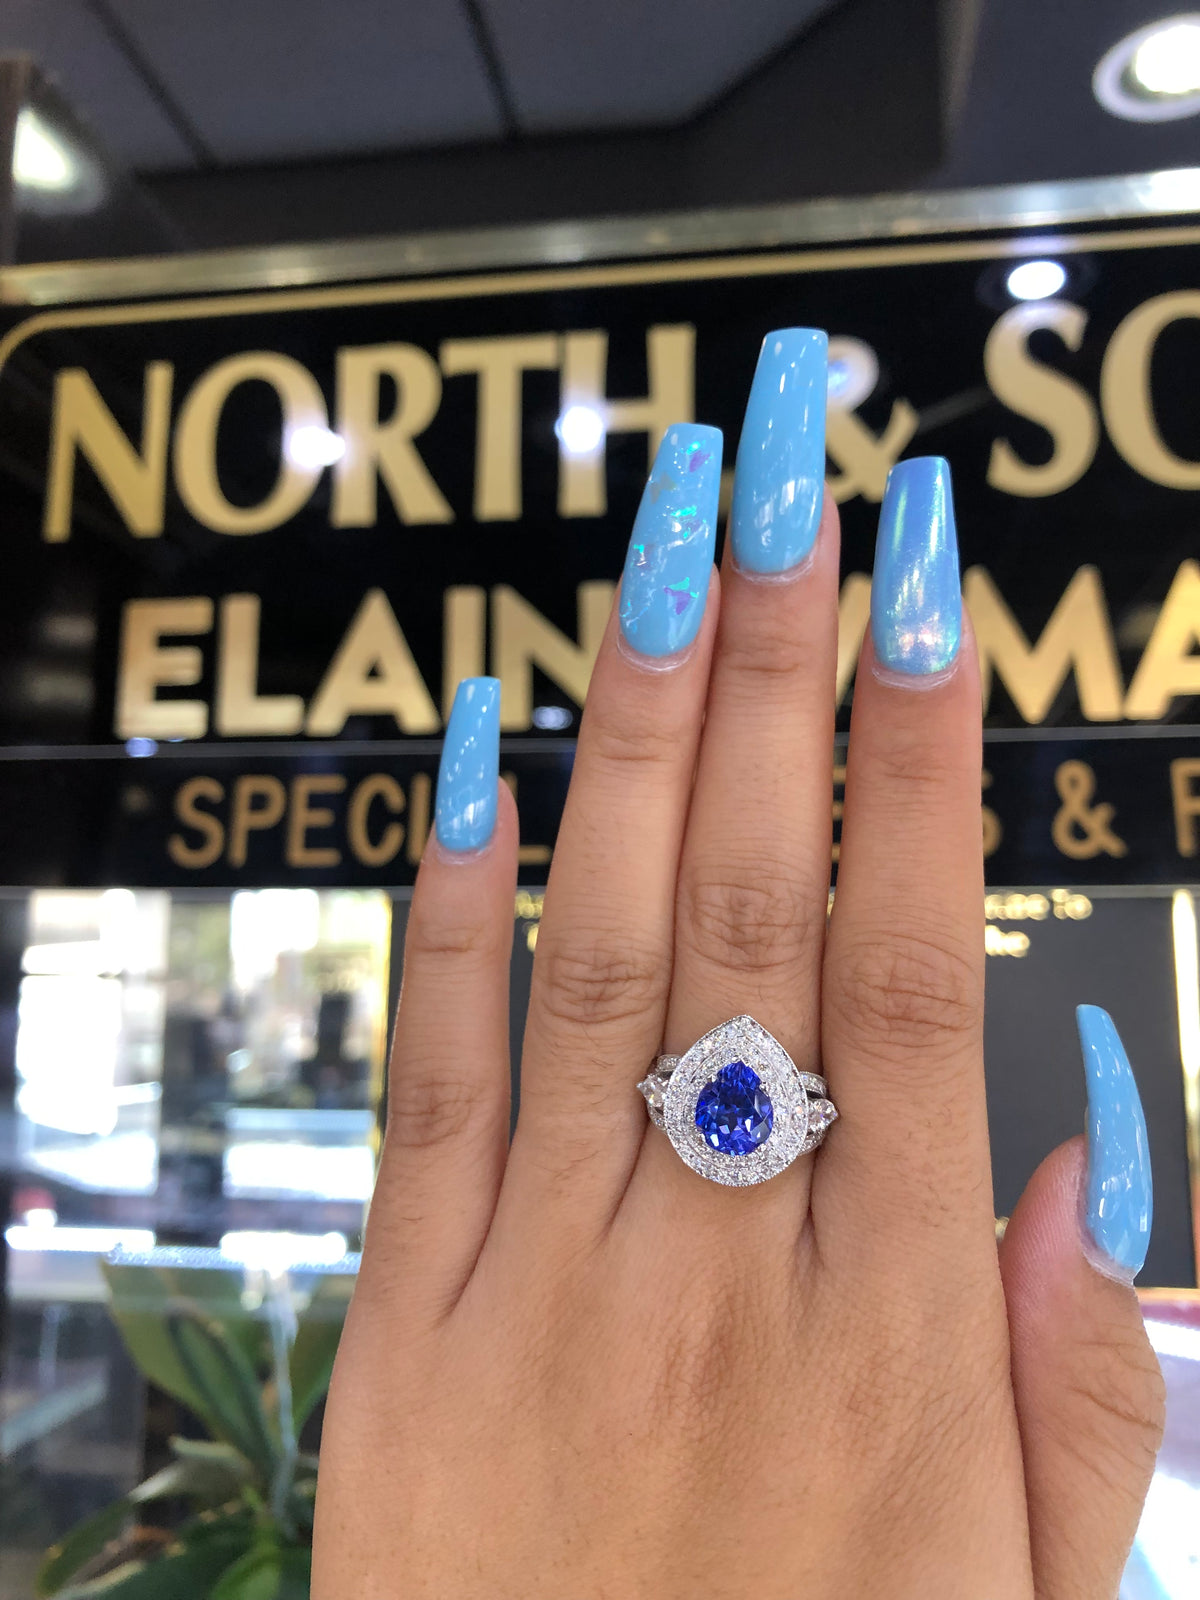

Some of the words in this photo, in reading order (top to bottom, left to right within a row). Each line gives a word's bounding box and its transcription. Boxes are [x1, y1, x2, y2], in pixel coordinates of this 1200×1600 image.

[42, 323, 698, 542] NORTH
[114, 579, 622, 740] ELAIN
[168, 770, 554, 870] SPECIL
[1052, 758, 1128, 862] &
